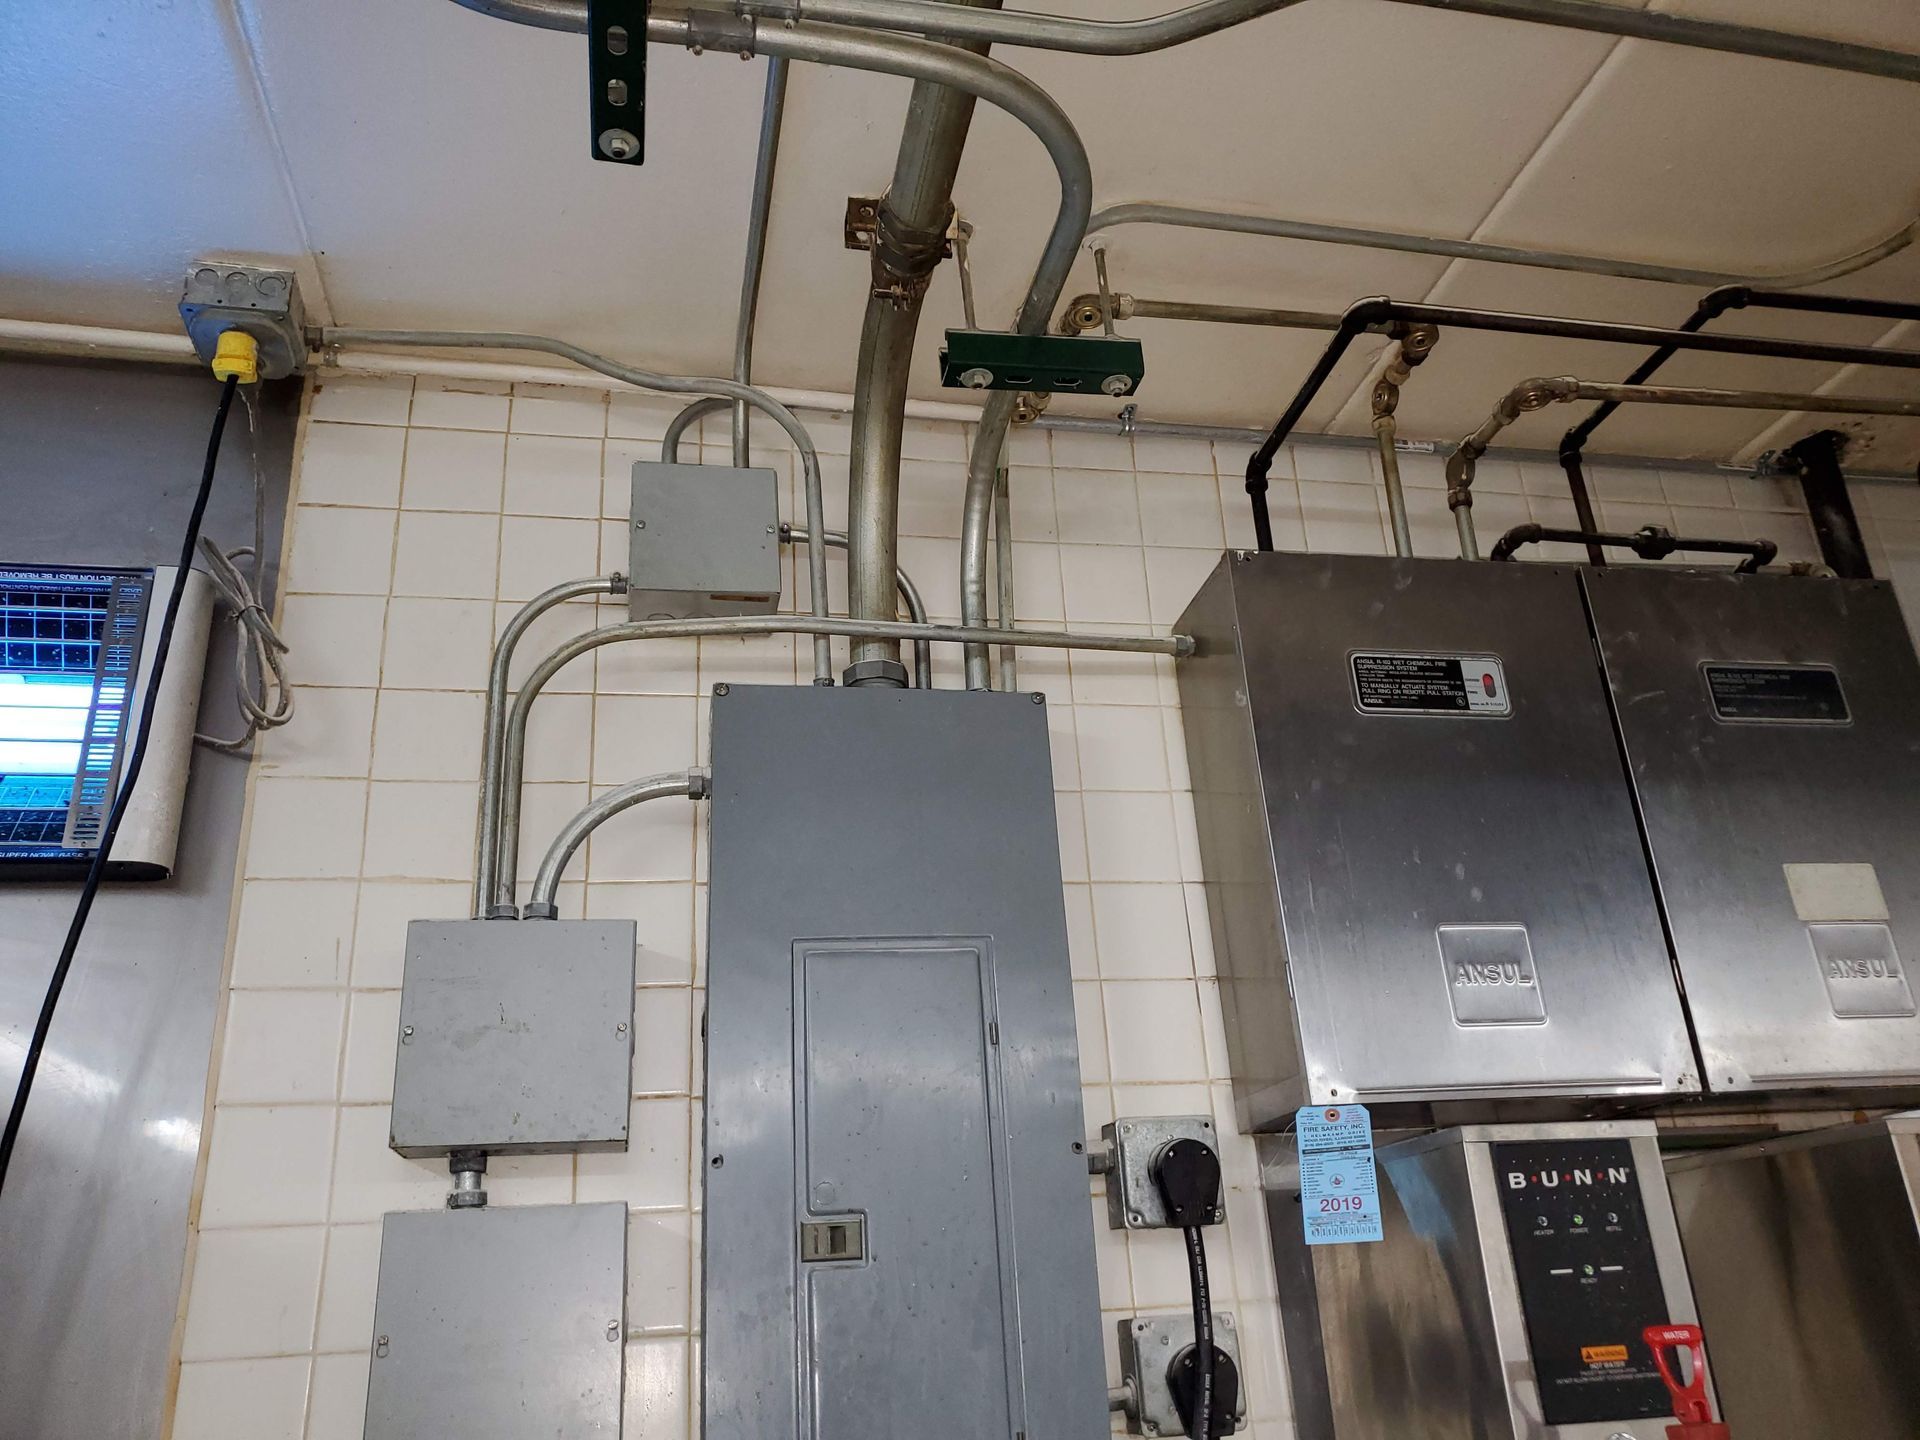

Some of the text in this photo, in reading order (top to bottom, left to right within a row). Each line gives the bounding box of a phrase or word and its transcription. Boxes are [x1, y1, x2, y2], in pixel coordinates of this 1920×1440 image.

[1455, 962, 1535, 986] ANSUL
[1826, 959, 1900, 980] ANSUL
[1319, 1196, 1363, 1213] 2019
[1662, 1330, 1690, 1339] WATER
